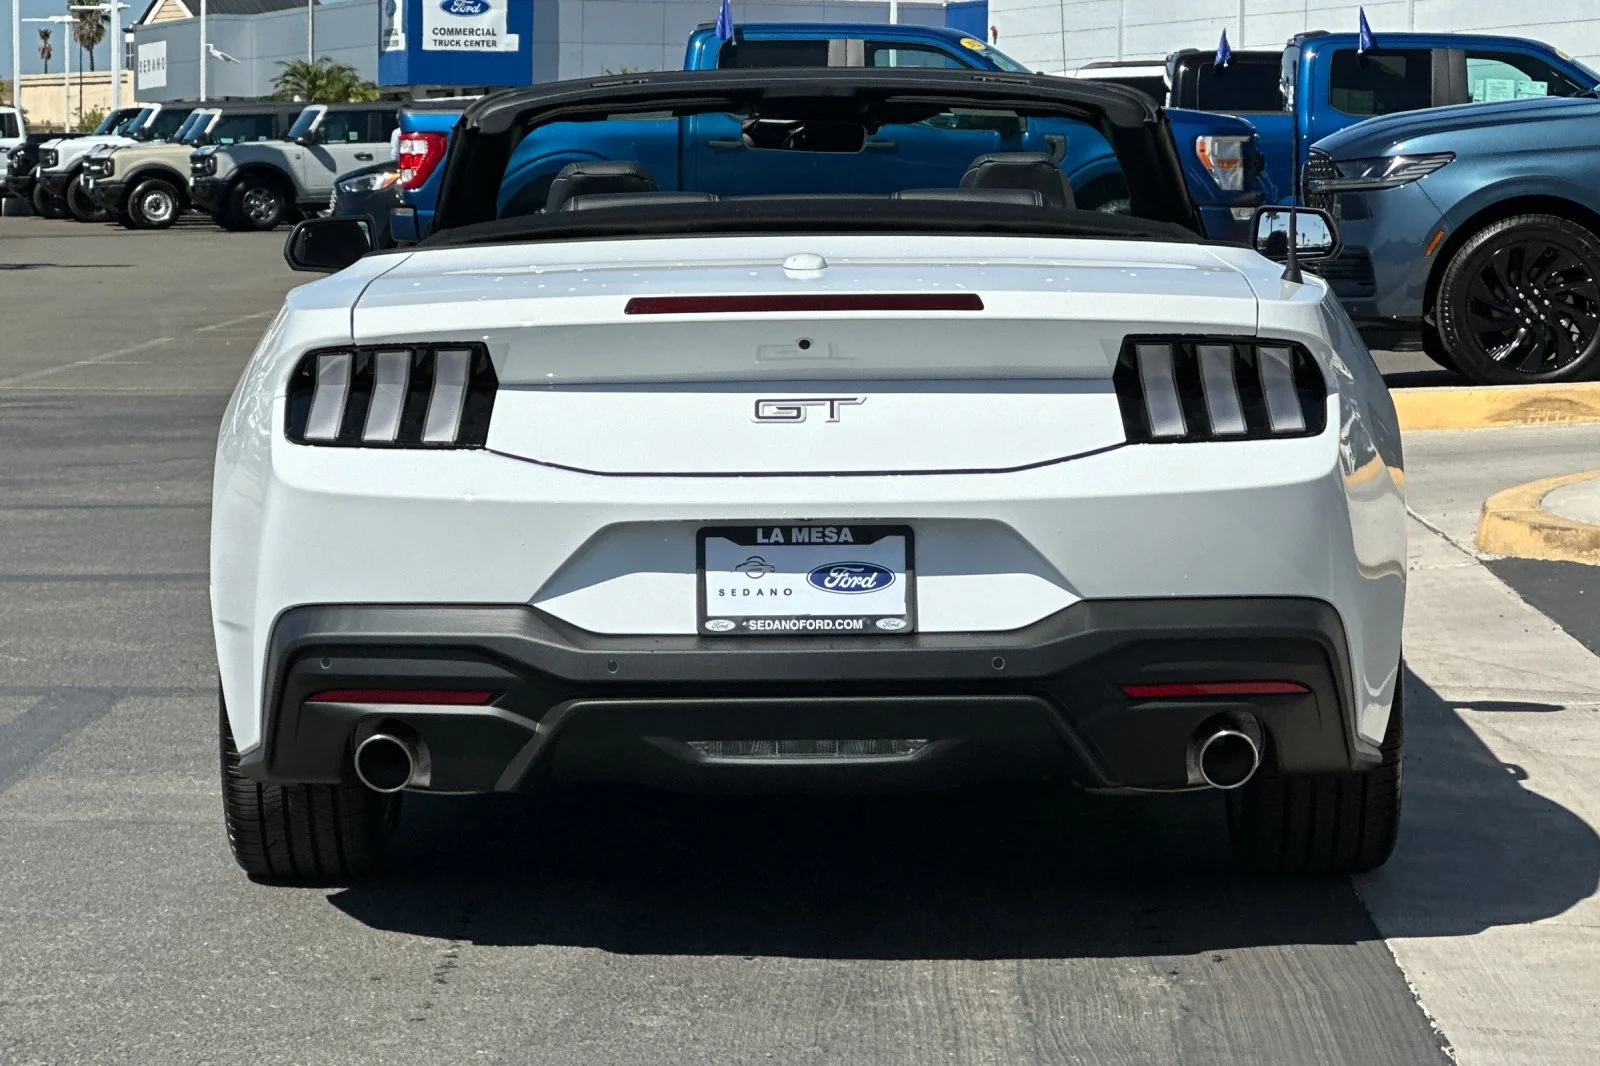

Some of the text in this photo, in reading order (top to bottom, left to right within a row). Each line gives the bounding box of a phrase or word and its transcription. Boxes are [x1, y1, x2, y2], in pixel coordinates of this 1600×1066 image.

[449, 0, 481, 13] Ford
[432, 27, 497, 37] COMMERCIAL
[433, 39, 498, 48] TRUCK CENTER
[751, 396, 868, 424] GT
[756, 527, 854, 543] LA MESA
[824, 566, 877, 589] Ford
[718, 587, 793, 597] SEDANO
[711, 621, 729, 629] Ford
[749, 618, 863, 631] SEDANOFORD.COM
[881, 619, 900, 628] Ford
